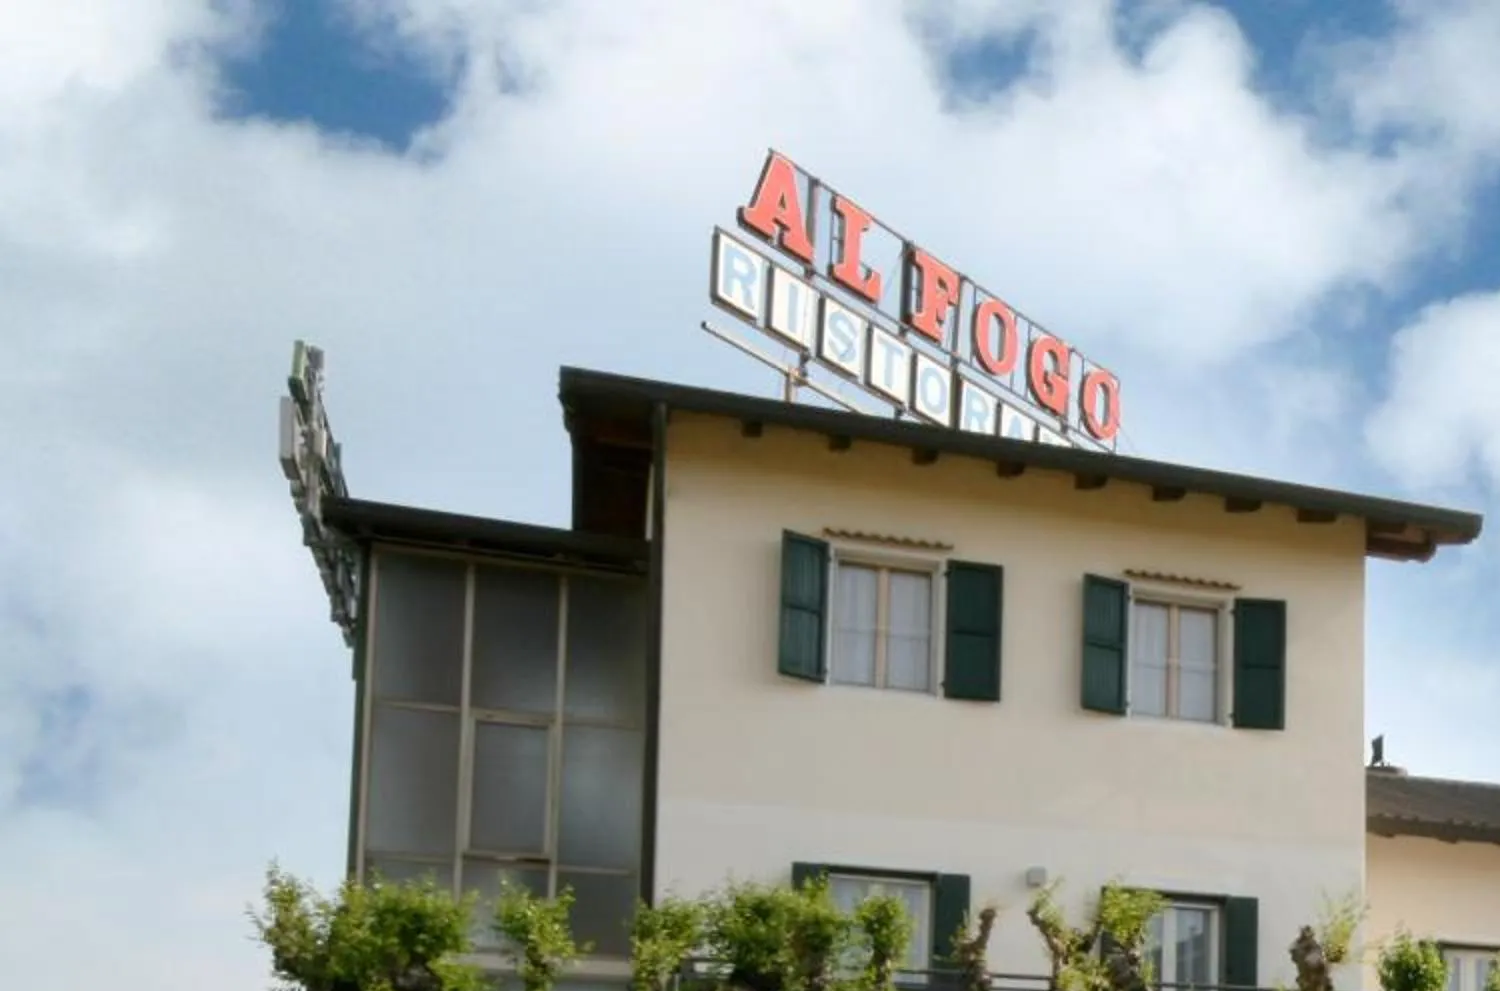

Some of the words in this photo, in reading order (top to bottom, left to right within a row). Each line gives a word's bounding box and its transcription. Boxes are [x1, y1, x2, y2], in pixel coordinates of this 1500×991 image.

[722, 241, 1042, 441] RISTORA
[738, 152, 881, 303] AL
[907, 247, 1120, 440] FOGO
